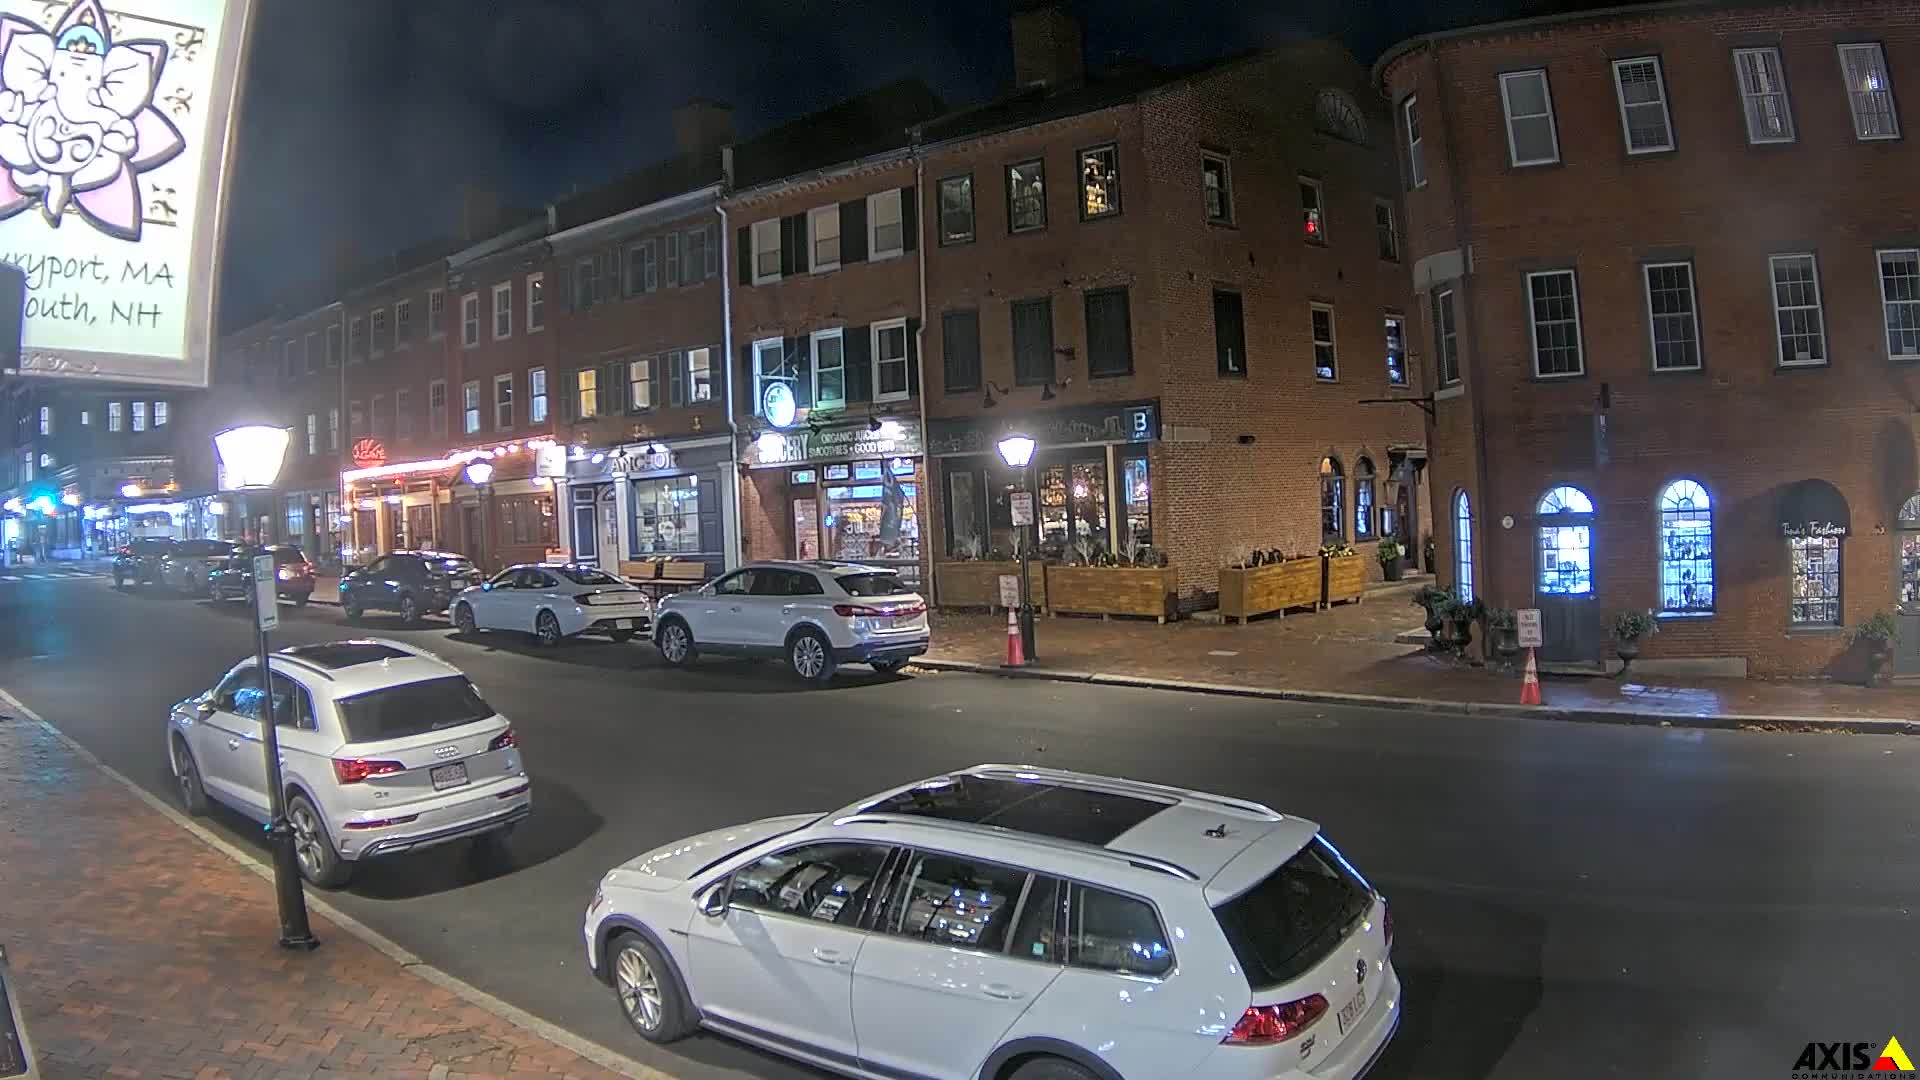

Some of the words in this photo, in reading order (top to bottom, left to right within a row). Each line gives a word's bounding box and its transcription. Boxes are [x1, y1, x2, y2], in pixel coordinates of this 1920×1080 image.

[121, 260, 174, 288] MA
[25, 292, 97, 326] outh,
[110, 300, 163, 328] NH
[821, 432, 853, 444] ORGANIC
[809, 445, 849, 458] SMOOTHIES
[855, 442, 877, 454] GOOD
